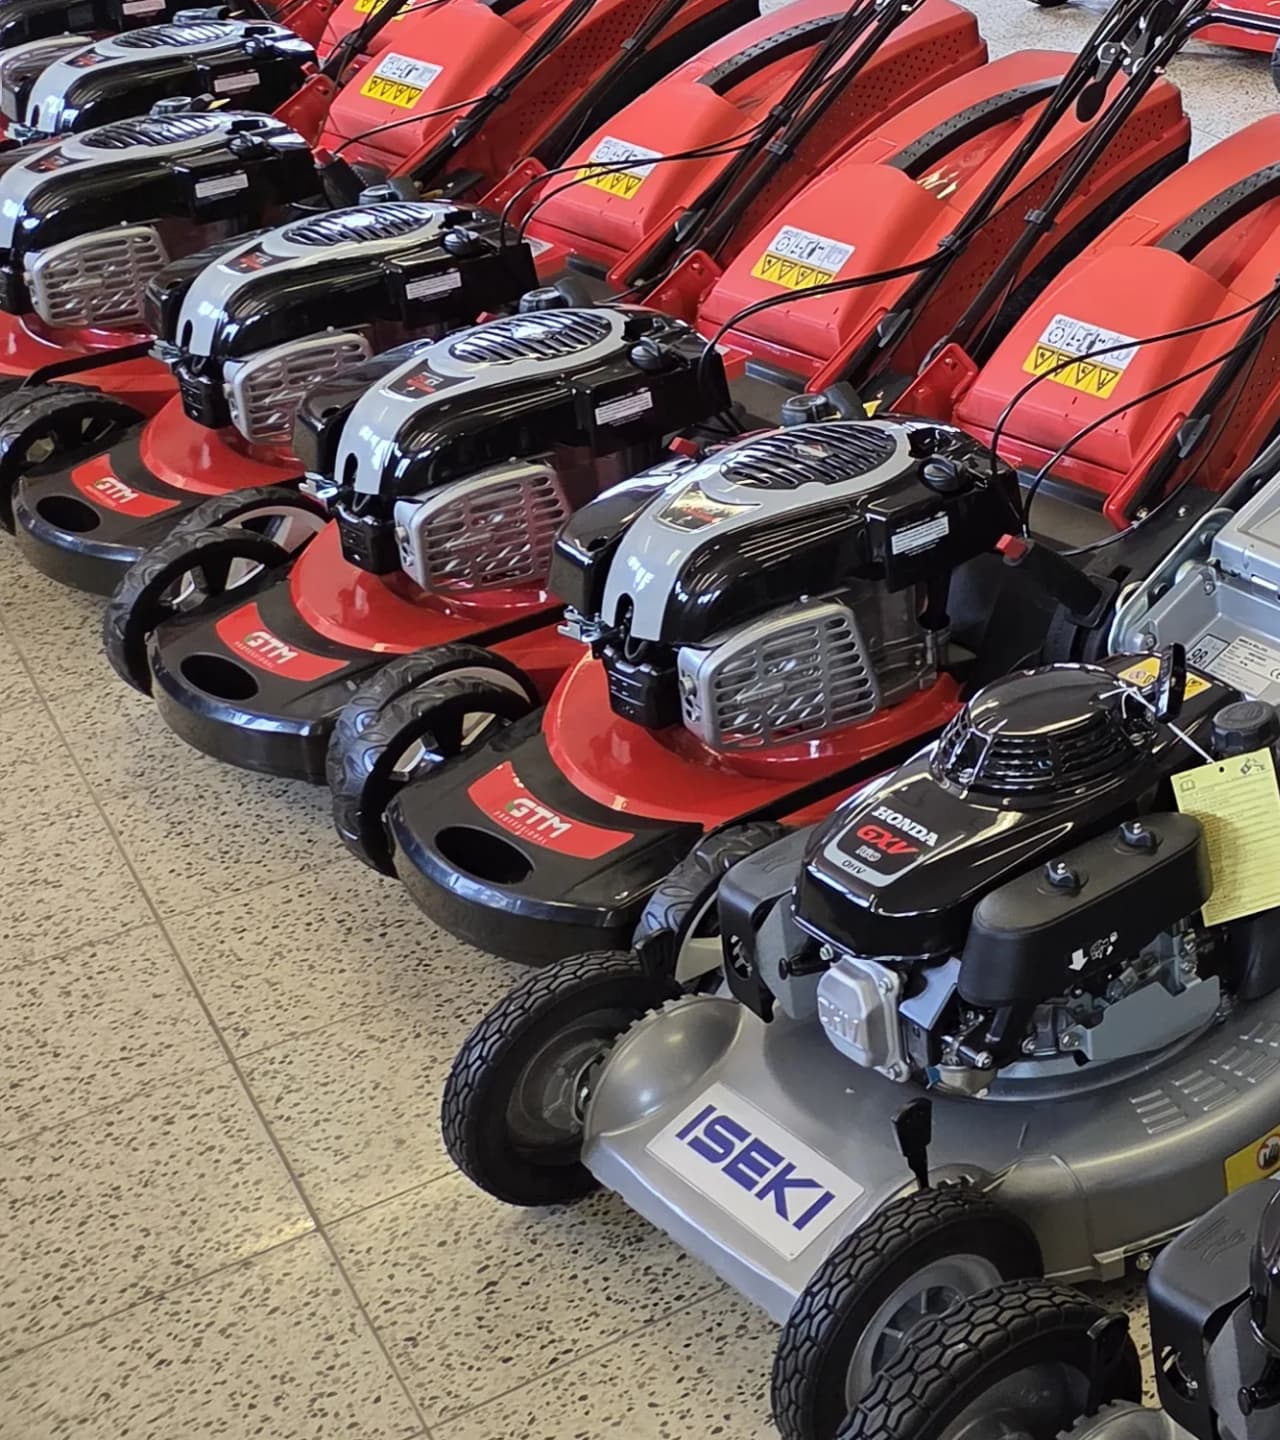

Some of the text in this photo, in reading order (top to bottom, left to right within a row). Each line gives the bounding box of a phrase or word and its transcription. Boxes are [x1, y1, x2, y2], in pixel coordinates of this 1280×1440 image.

[94, 476, 140, 504] GTM
[243, 631, 299, 665] GTM
[504, 796, 573, 840] GTM
[871, 806, 940, 849] HONDA
[856, 824, 920, 856] GXV
[675, 1103, 836, 1233] ISEKI
